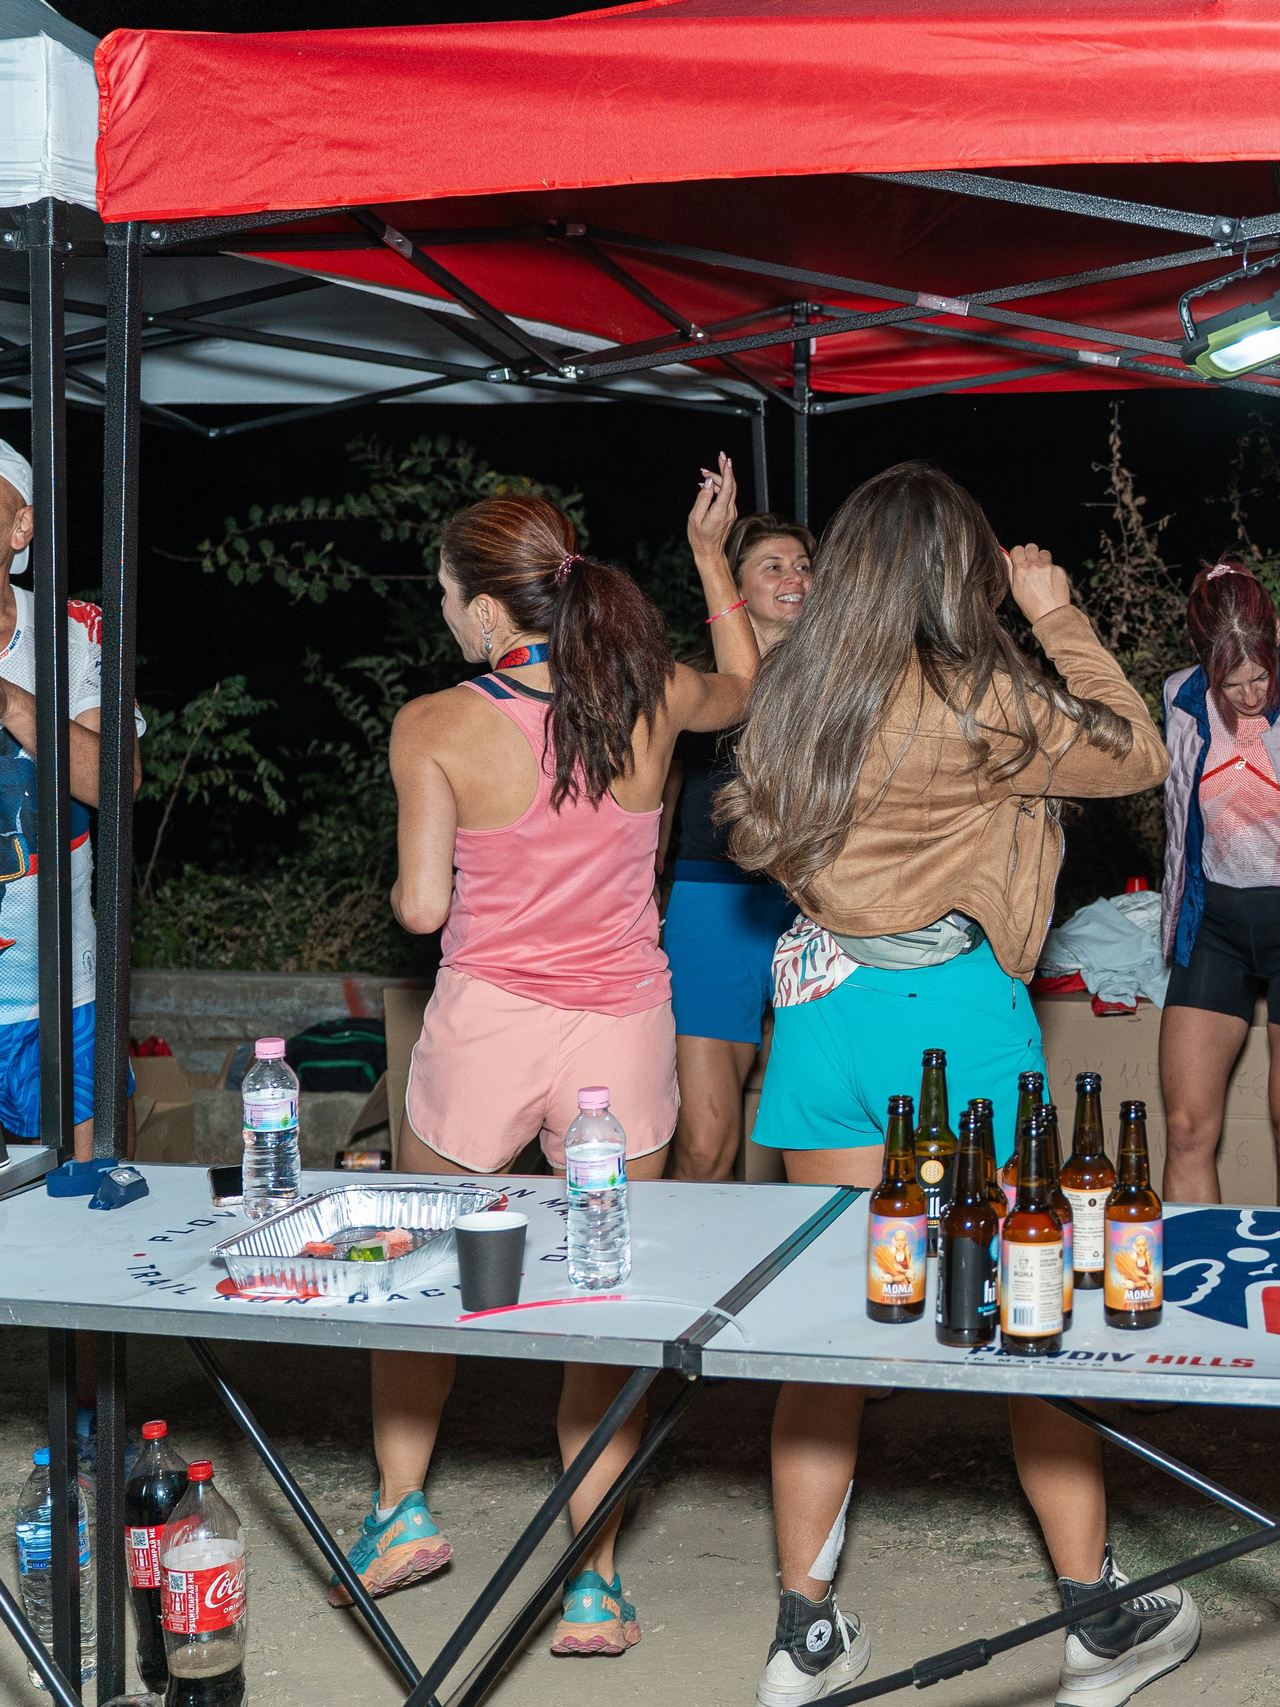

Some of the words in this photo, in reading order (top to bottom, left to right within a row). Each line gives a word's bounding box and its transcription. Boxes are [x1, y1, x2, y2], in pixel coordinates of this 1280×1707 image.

[126, 1263, 198, 1295] TRAIL
[347, 1284, 461, 1304] RAC
[882, 1283, 914, 1294] MOMA
[1124, 1289, 1155, 1300] MOMA
[968, 1345, 1136, 1363] PLVDIV
[1145, 1354, 1256, 1368] HILLS
[997, 1358, 1104, 1367] MARKOVO
[376, 1519, 407, 1556] HOKA
[223, 1600, 243, 1614] ORIG
